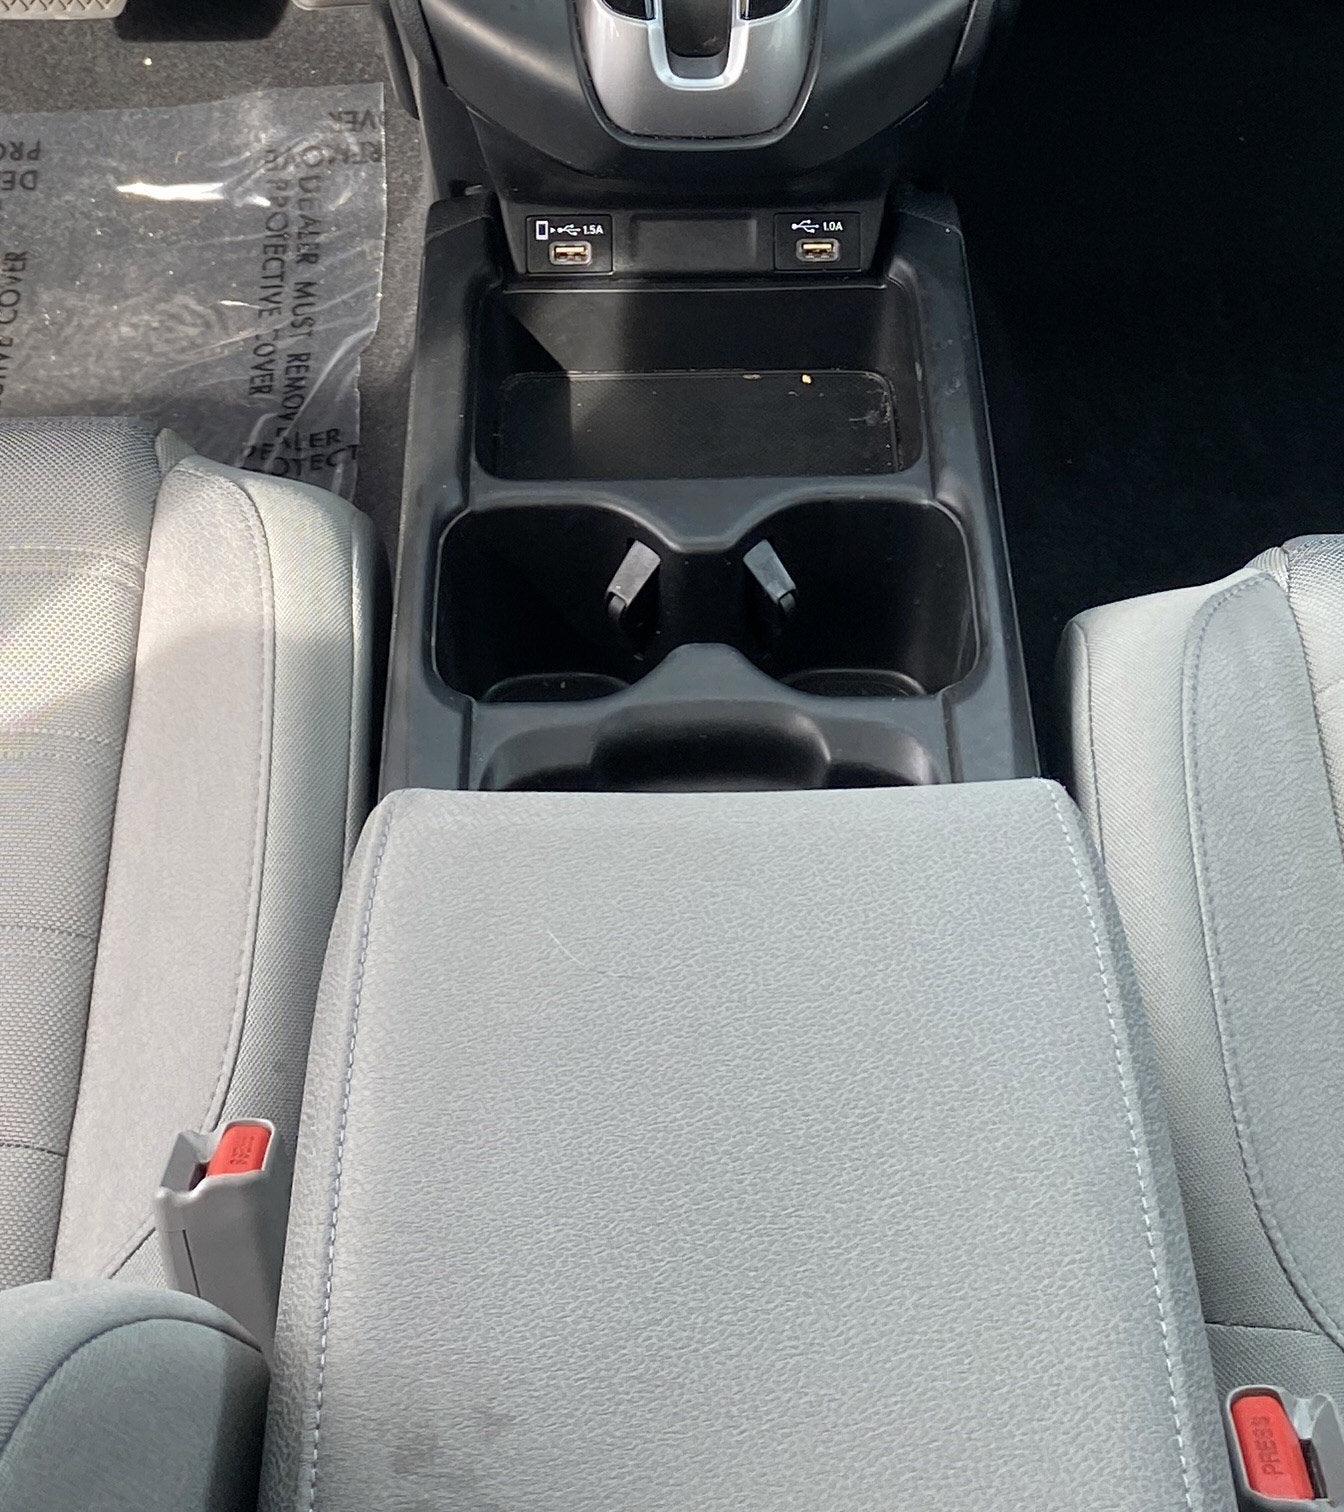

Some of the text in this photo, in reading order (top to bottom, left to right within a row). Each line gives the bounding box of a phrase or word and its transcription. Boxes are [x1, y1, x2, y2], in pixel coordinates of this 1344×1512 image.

[295, 176, 324, 265] DEALER
[582, 224, 604, 236] 1.5A
[822, 221, 844, 232] 1.0A
[289, 281, 318, 337] MUST
